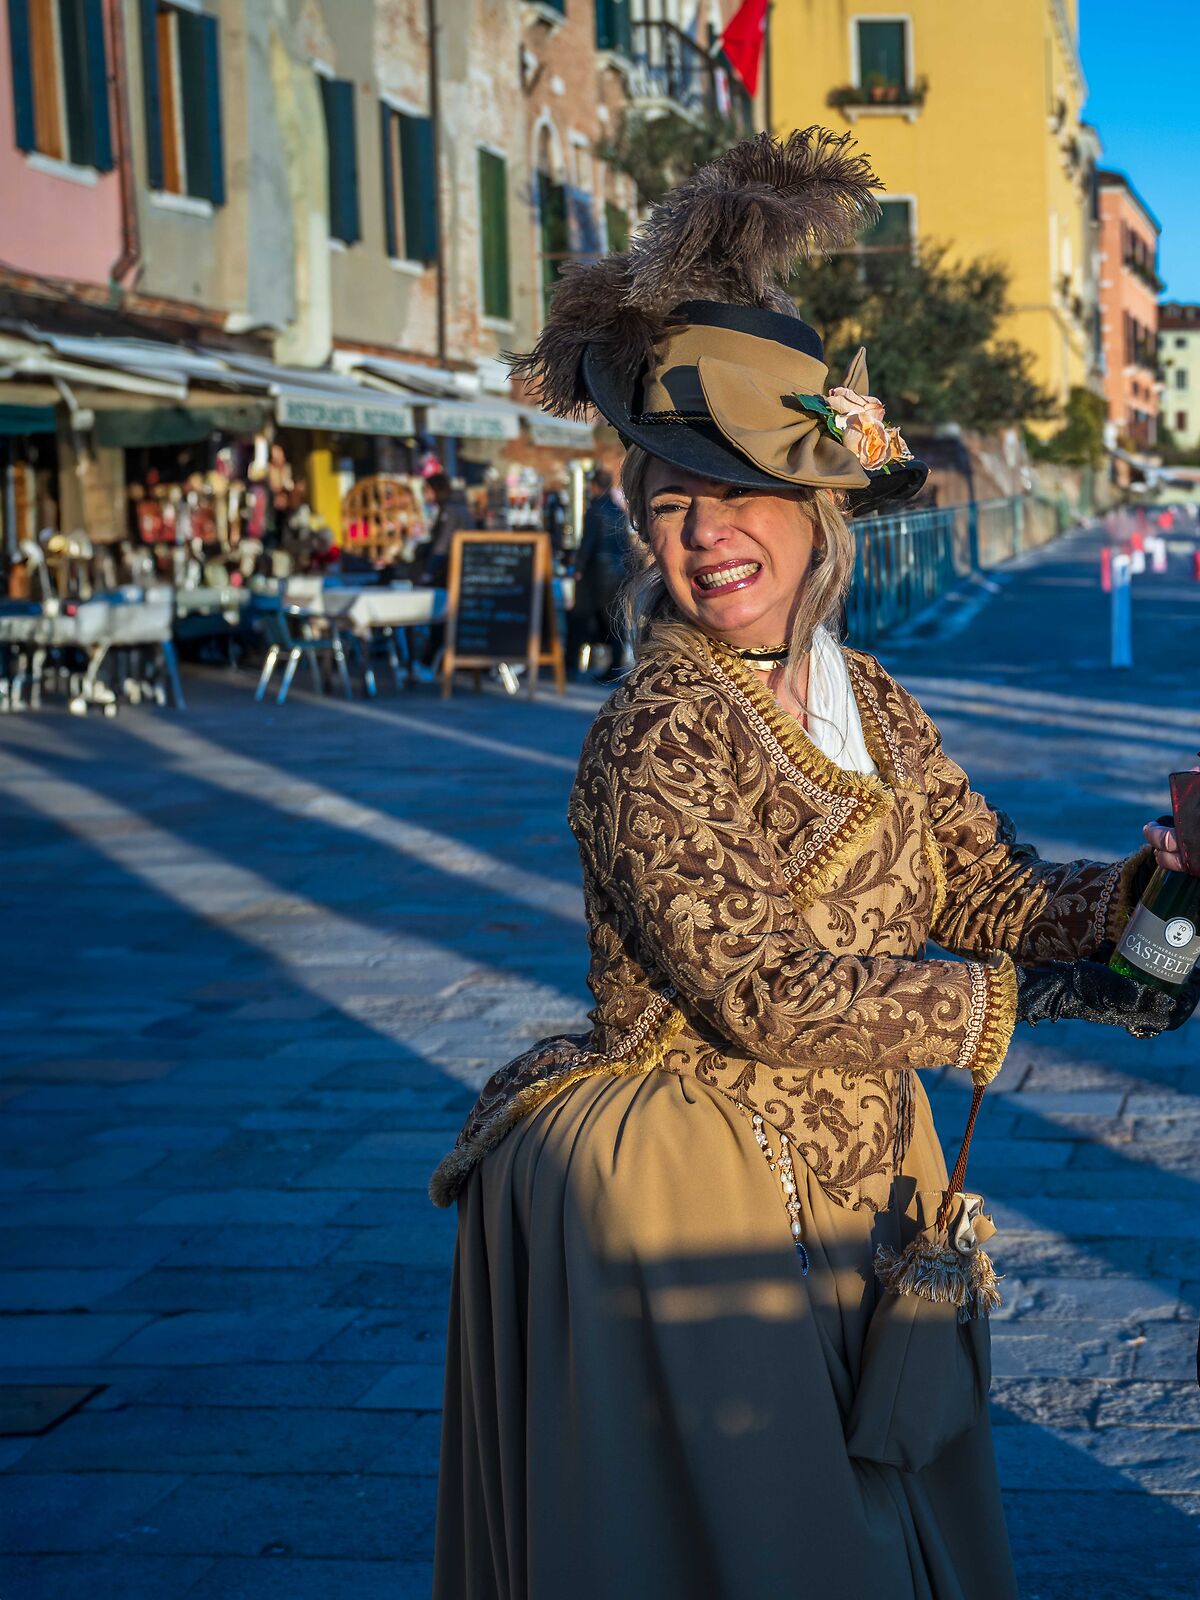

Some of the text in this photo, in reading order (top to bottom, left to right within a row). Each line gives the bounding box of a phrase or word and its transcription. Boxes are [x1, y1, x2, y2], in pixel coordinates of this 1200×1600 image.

[1126, 934, 1193, 975] CASTELL
[1152, 943, 1178, 958] MINERALE
[1145, 962, 1174, 977] NATURALE
